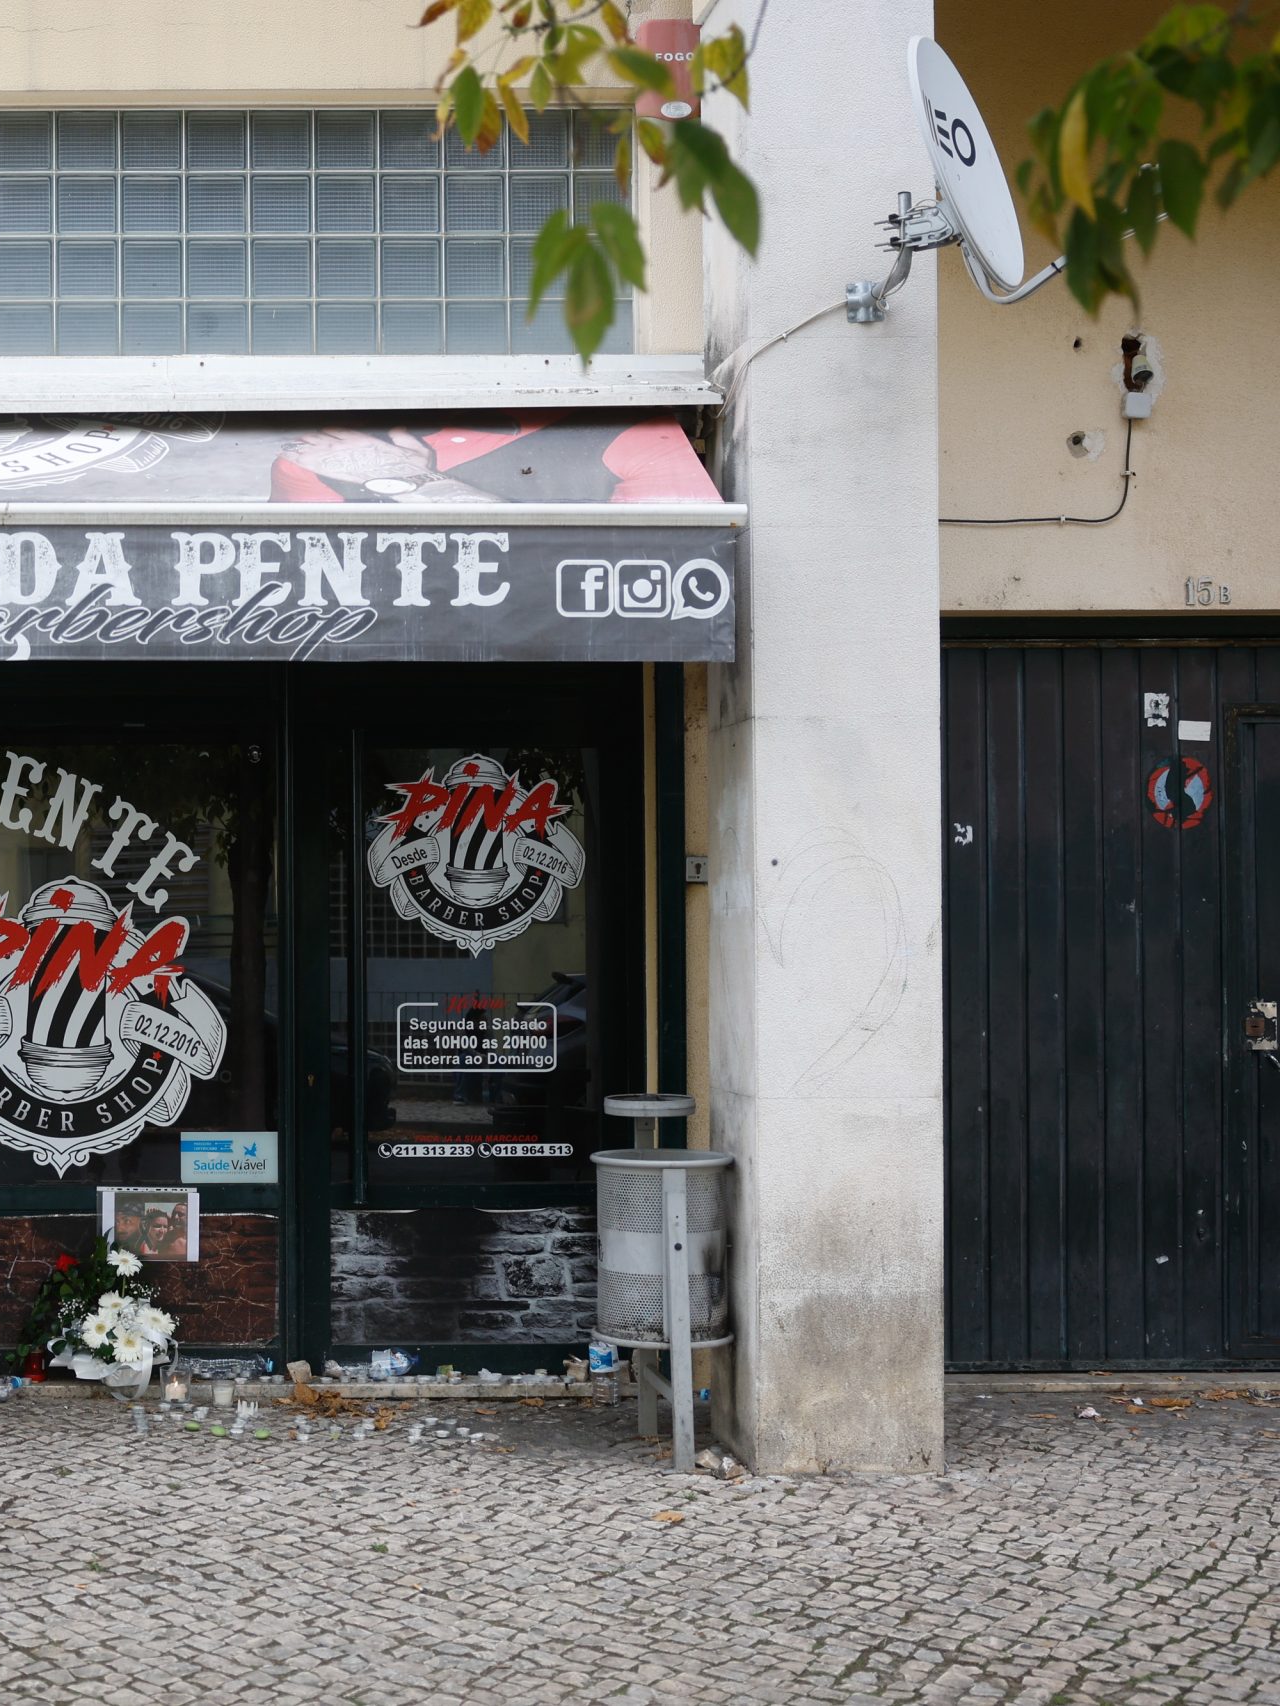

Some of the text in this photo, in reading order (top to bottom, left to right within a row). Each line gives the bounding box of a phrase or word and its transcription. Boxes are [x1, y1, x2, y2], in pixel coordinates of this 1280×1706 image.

[1, 428, 121, 474] SHOP
[171, 531, 510, 609] PENTE
[381, 762, 570, 845] PINA
[391, 847, 428, 870] Desde
[522, 845, 569, 875] 02.12.2016
[409, 875, 544, 927] BARBER SHOP
[133, 1014, 201, 1058] 02.12.2016
[409, 1017, 547, 1033] Segunda a Sabado
[403, 1035, 547, 1049] das 10H00 as 20H00
[403, 1052, 554, 1067] Encerra ao Domingo
[96, 1058, 163, 1123] SHOP
[395, 1146, 572, 1156] 211 313 233 918 964 513
[464, 1135, 483, 1143] SUA
[193, 1158, 230, 1171] Saúde
